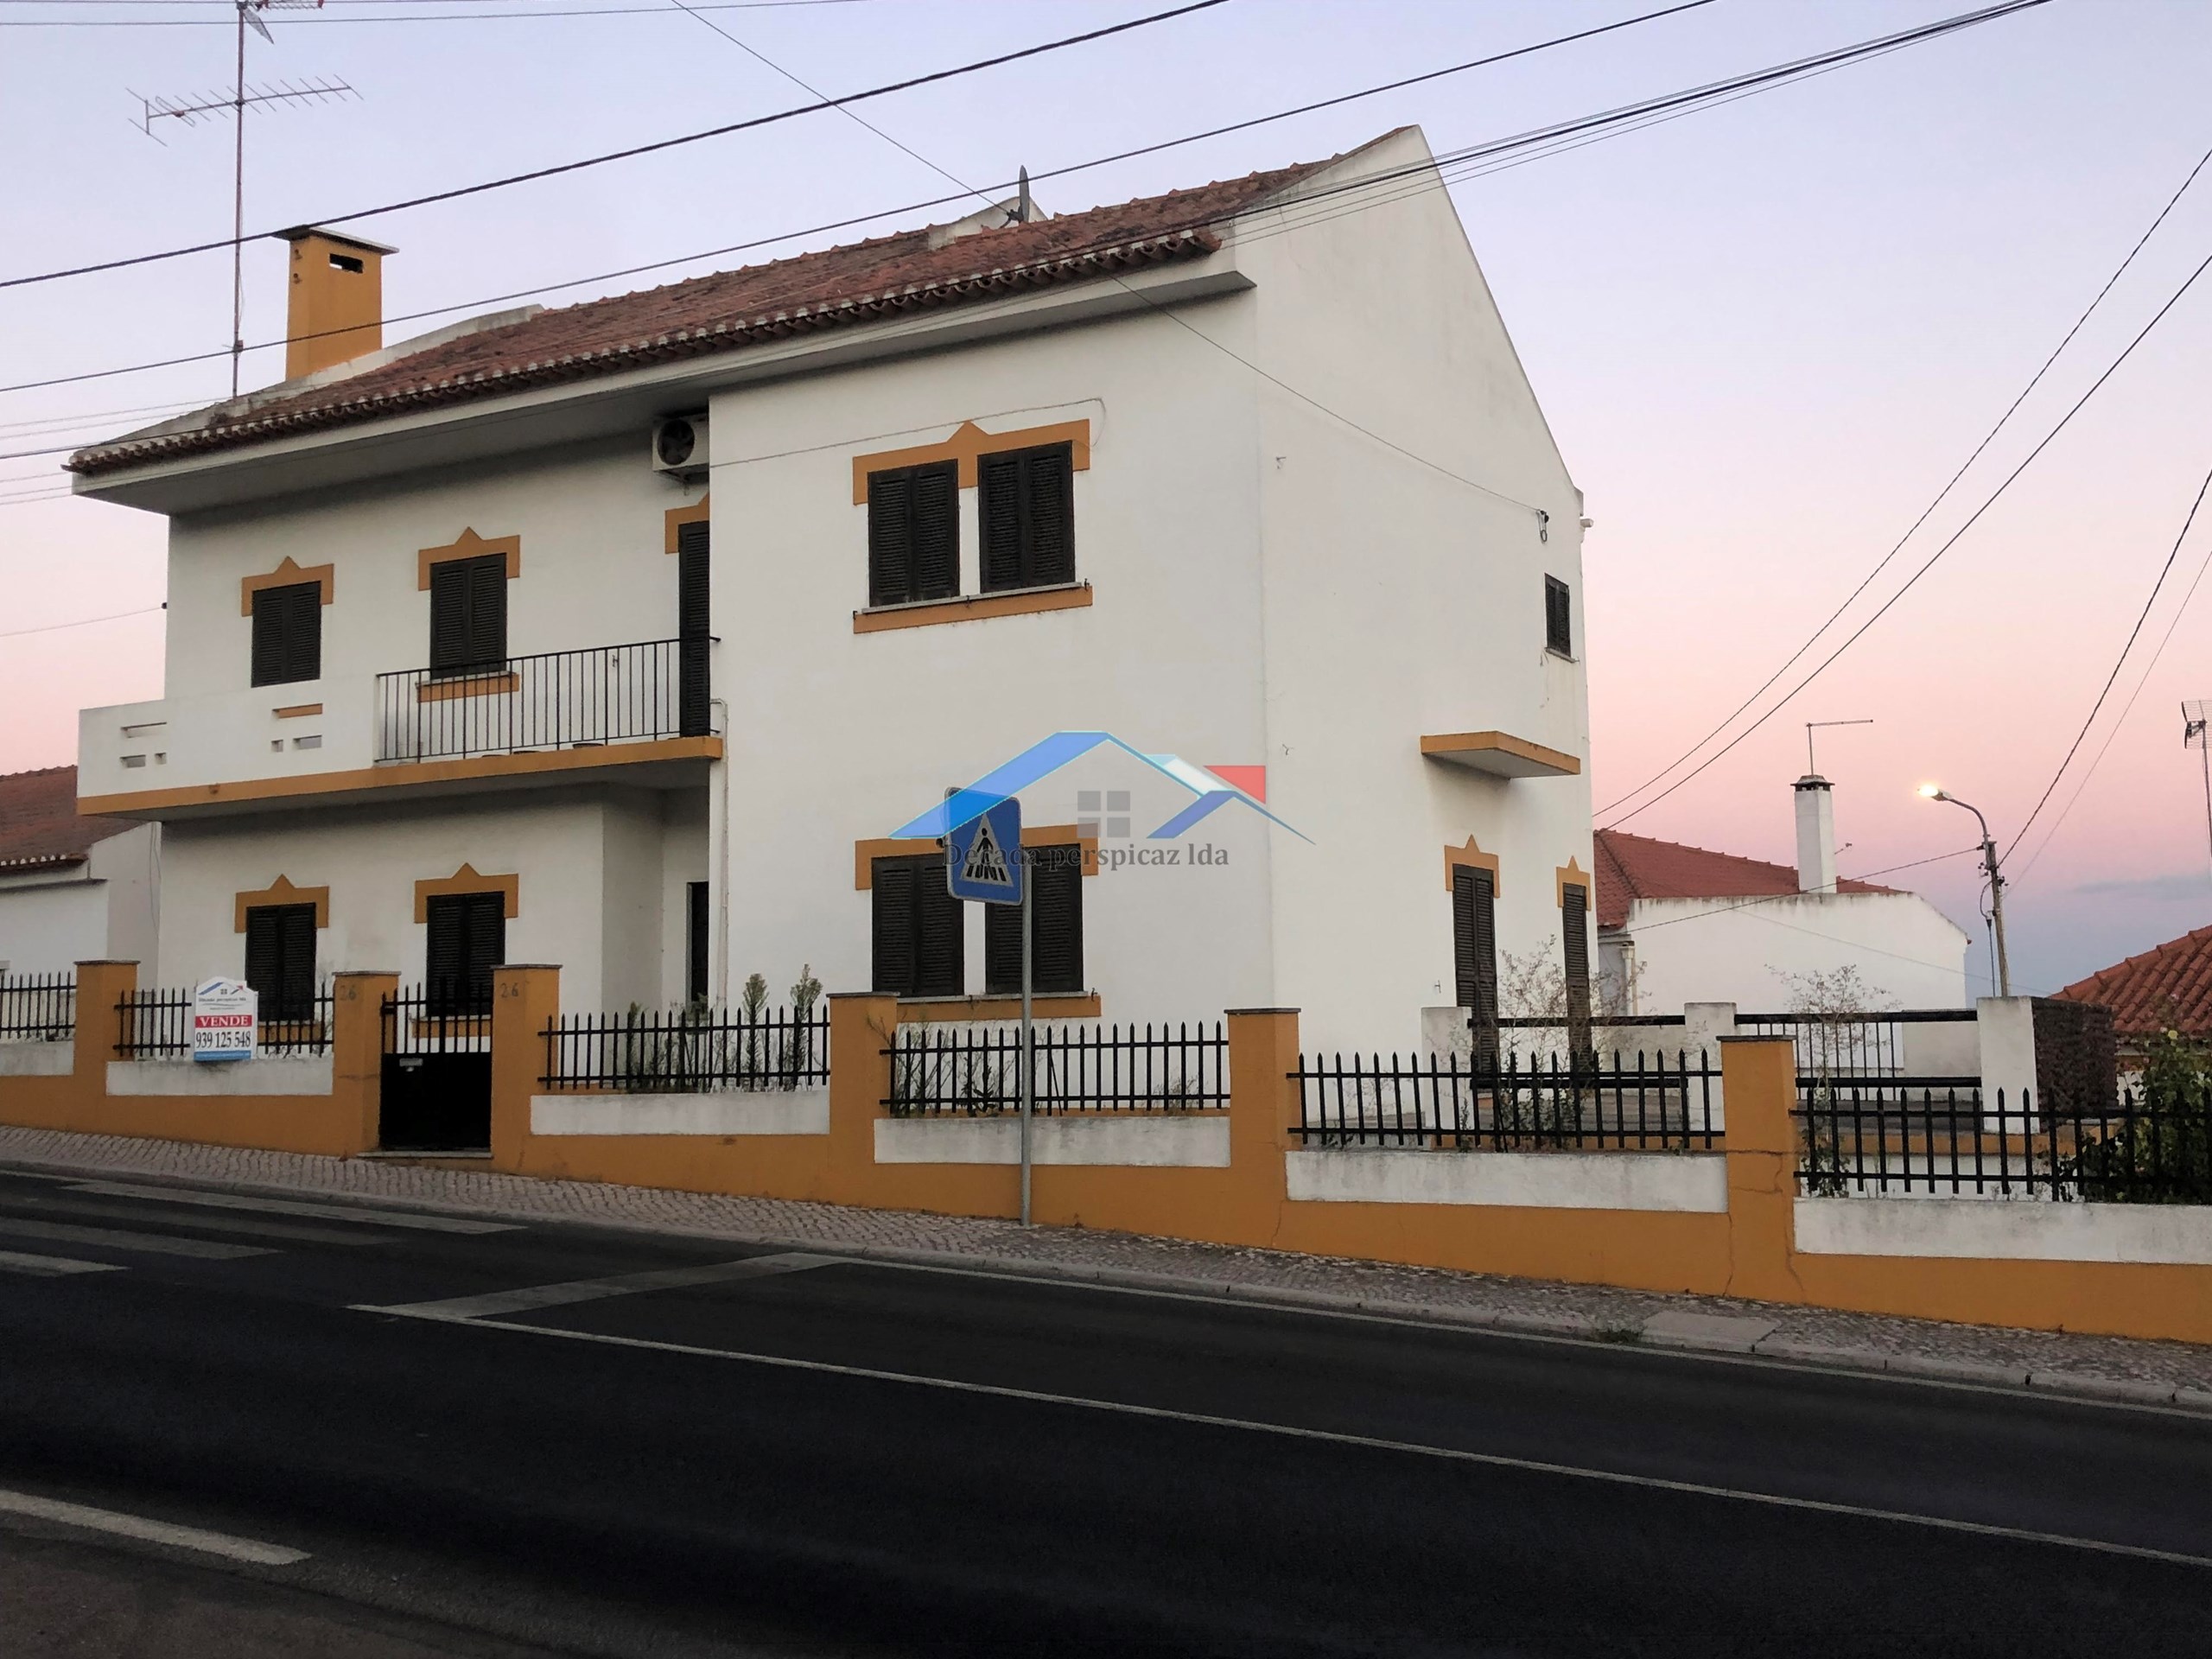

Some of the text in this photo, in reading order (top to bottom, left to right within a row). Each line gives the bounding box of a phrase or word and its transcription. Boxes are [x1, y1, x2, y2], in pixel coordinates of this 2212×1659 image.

[500, 982, 518, 998] 26
[200, 1016, 249, 1027] VENDE
[195, 1031, 251, 1048] 939 125 548
